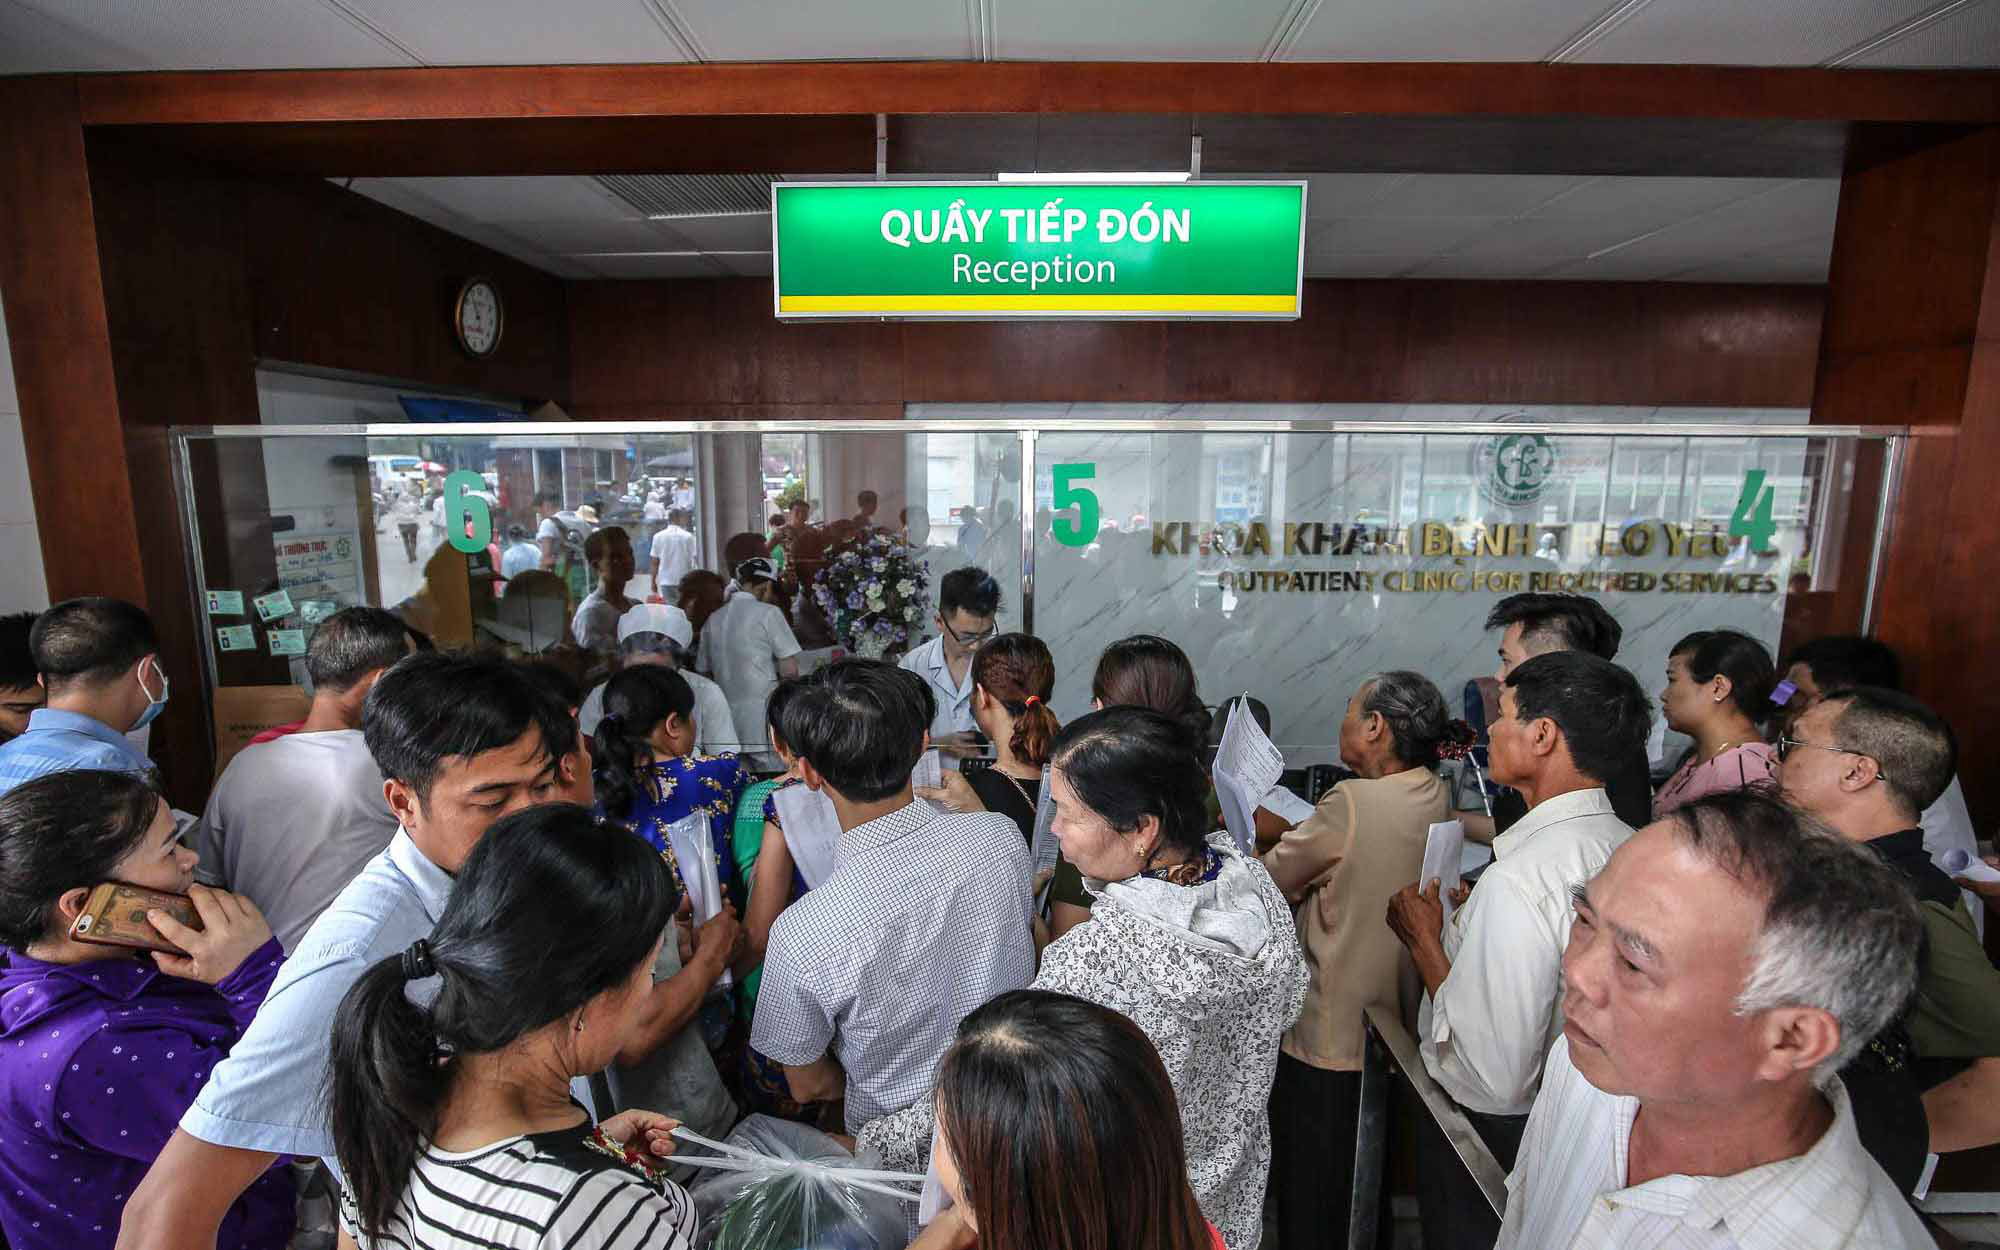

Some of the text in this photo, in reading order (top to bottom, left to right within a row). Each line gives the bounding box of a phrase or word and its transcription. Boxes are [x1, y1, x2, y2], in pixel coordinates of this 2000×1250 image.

[880, 198, 1191, 247] QUẦY TIẾP ĐÓN
[953, 253, 1115, 290] Reception
[444, 470, 490, 552] 6
[1053, 463, 1099, 547] 5
[1728, 470, 1776, 551] 4
[1217, 570, 1374, 592] OUTPATIENT
[1384, 571, 1463, 592] CLINIC
[1472, 572, 1521, 592] FOR
[1662, 572, 1777, 593] SERVICES
